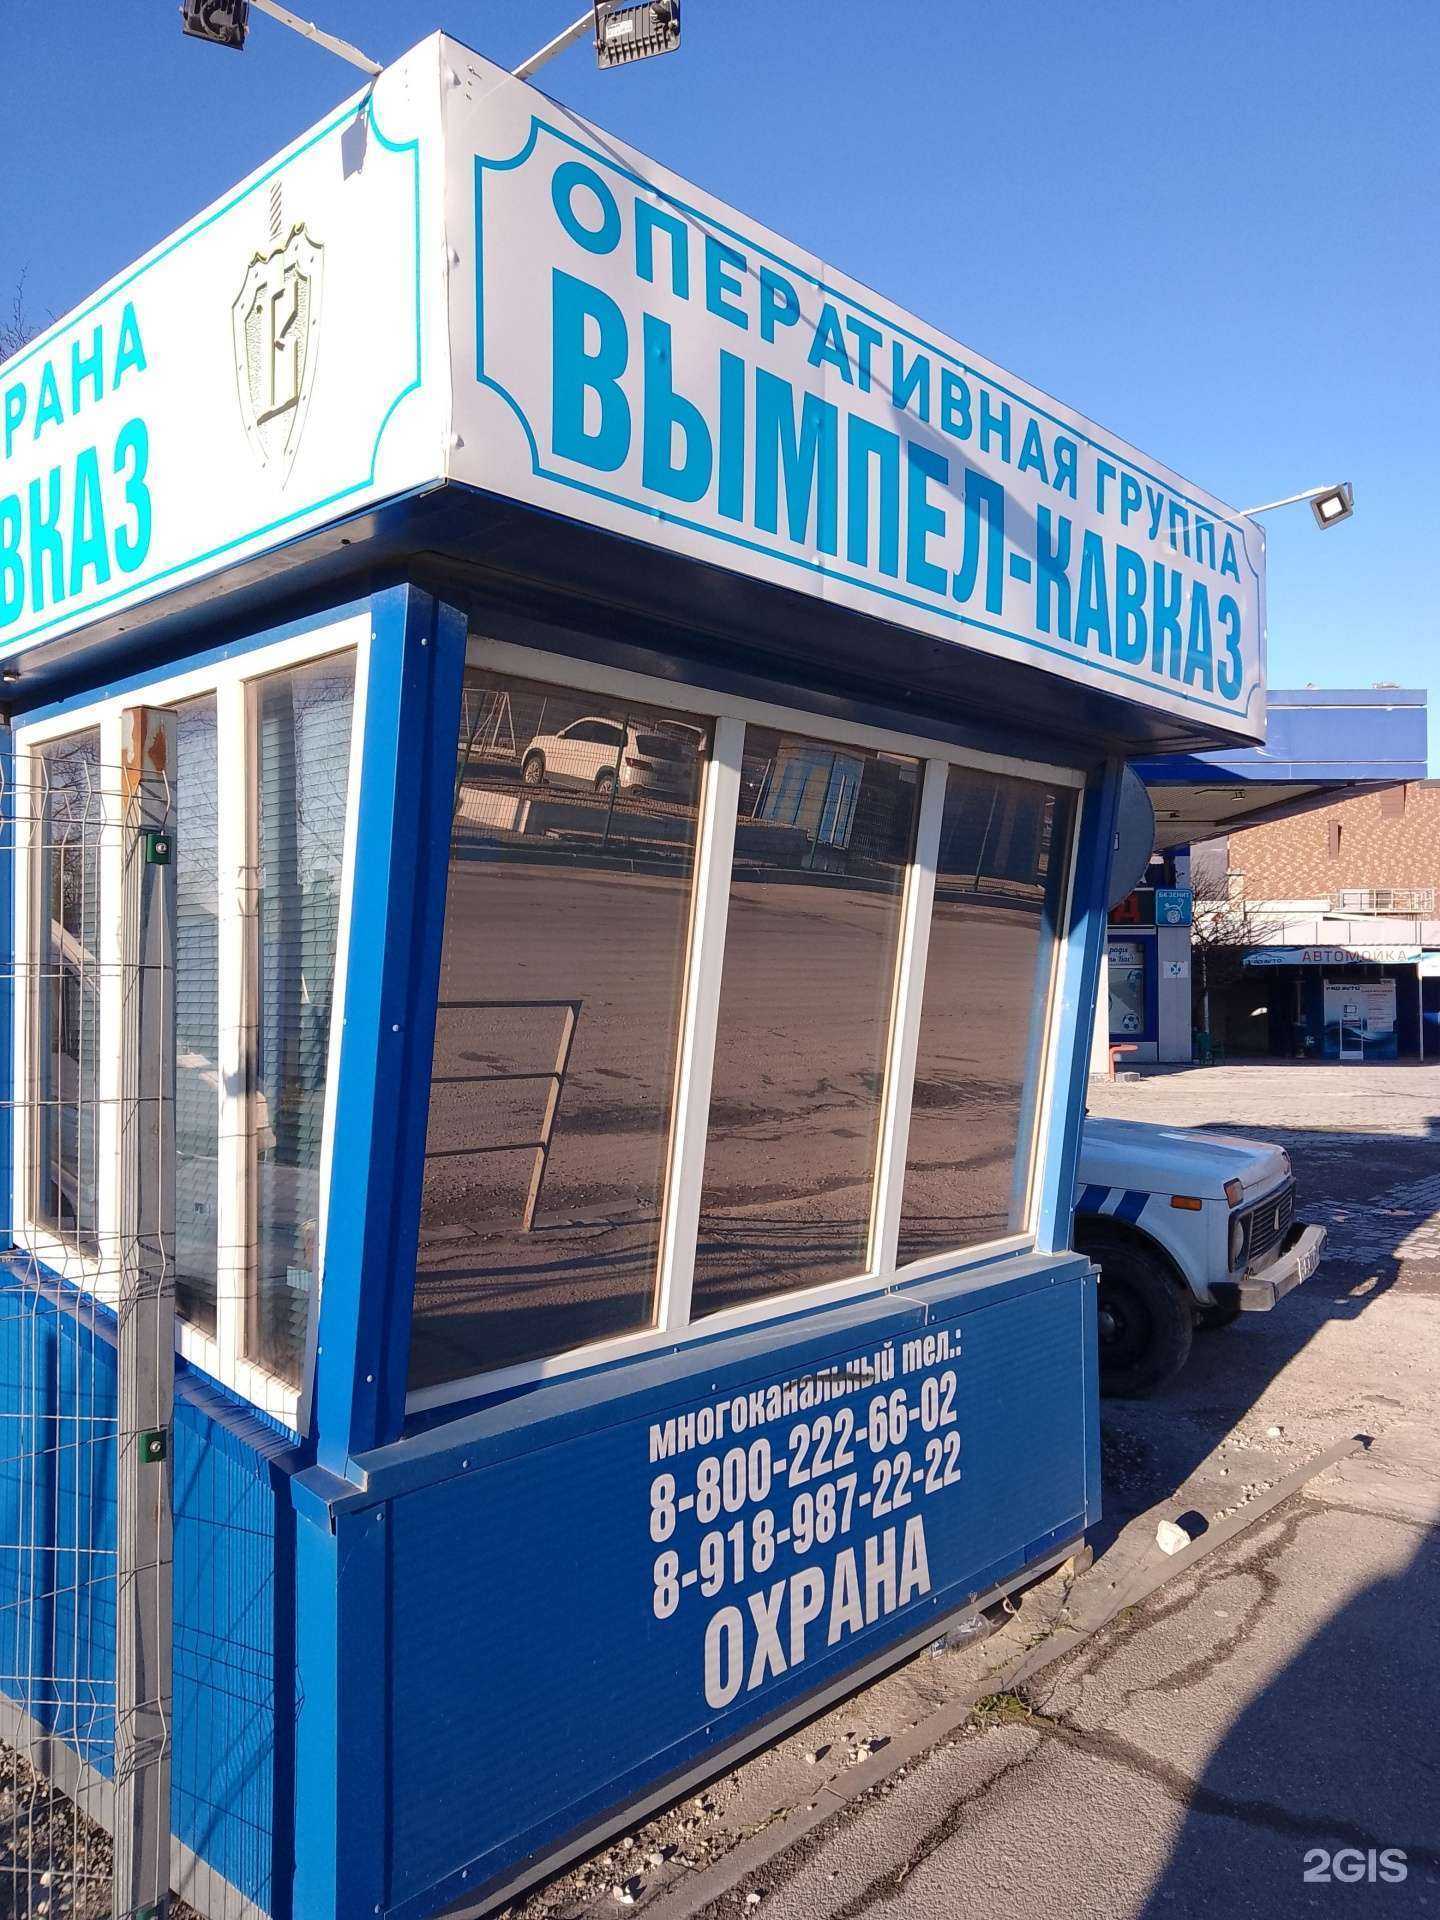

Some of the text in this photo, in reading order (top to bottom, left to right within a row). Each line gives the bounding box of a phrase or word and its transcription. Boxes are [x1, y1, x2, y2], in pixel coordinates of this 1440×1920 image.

[5, 300, 147, 459] РАНА
[551, 161, 1241, 584] ОПЕРАТИВНАЯ ГРУППА
[552, 266, 1243, 701] ВЫМПЕЛ-КАВКАЗ
[1302, 950, 1408, 963] АВТОМОЙКА
[649, 1370, 958, 1543] 8-800-222-66-02
[653, 1430, 961, 1620] 8-918-987-22-22
[704, 1513, 931, 1709] ОХРАНА
